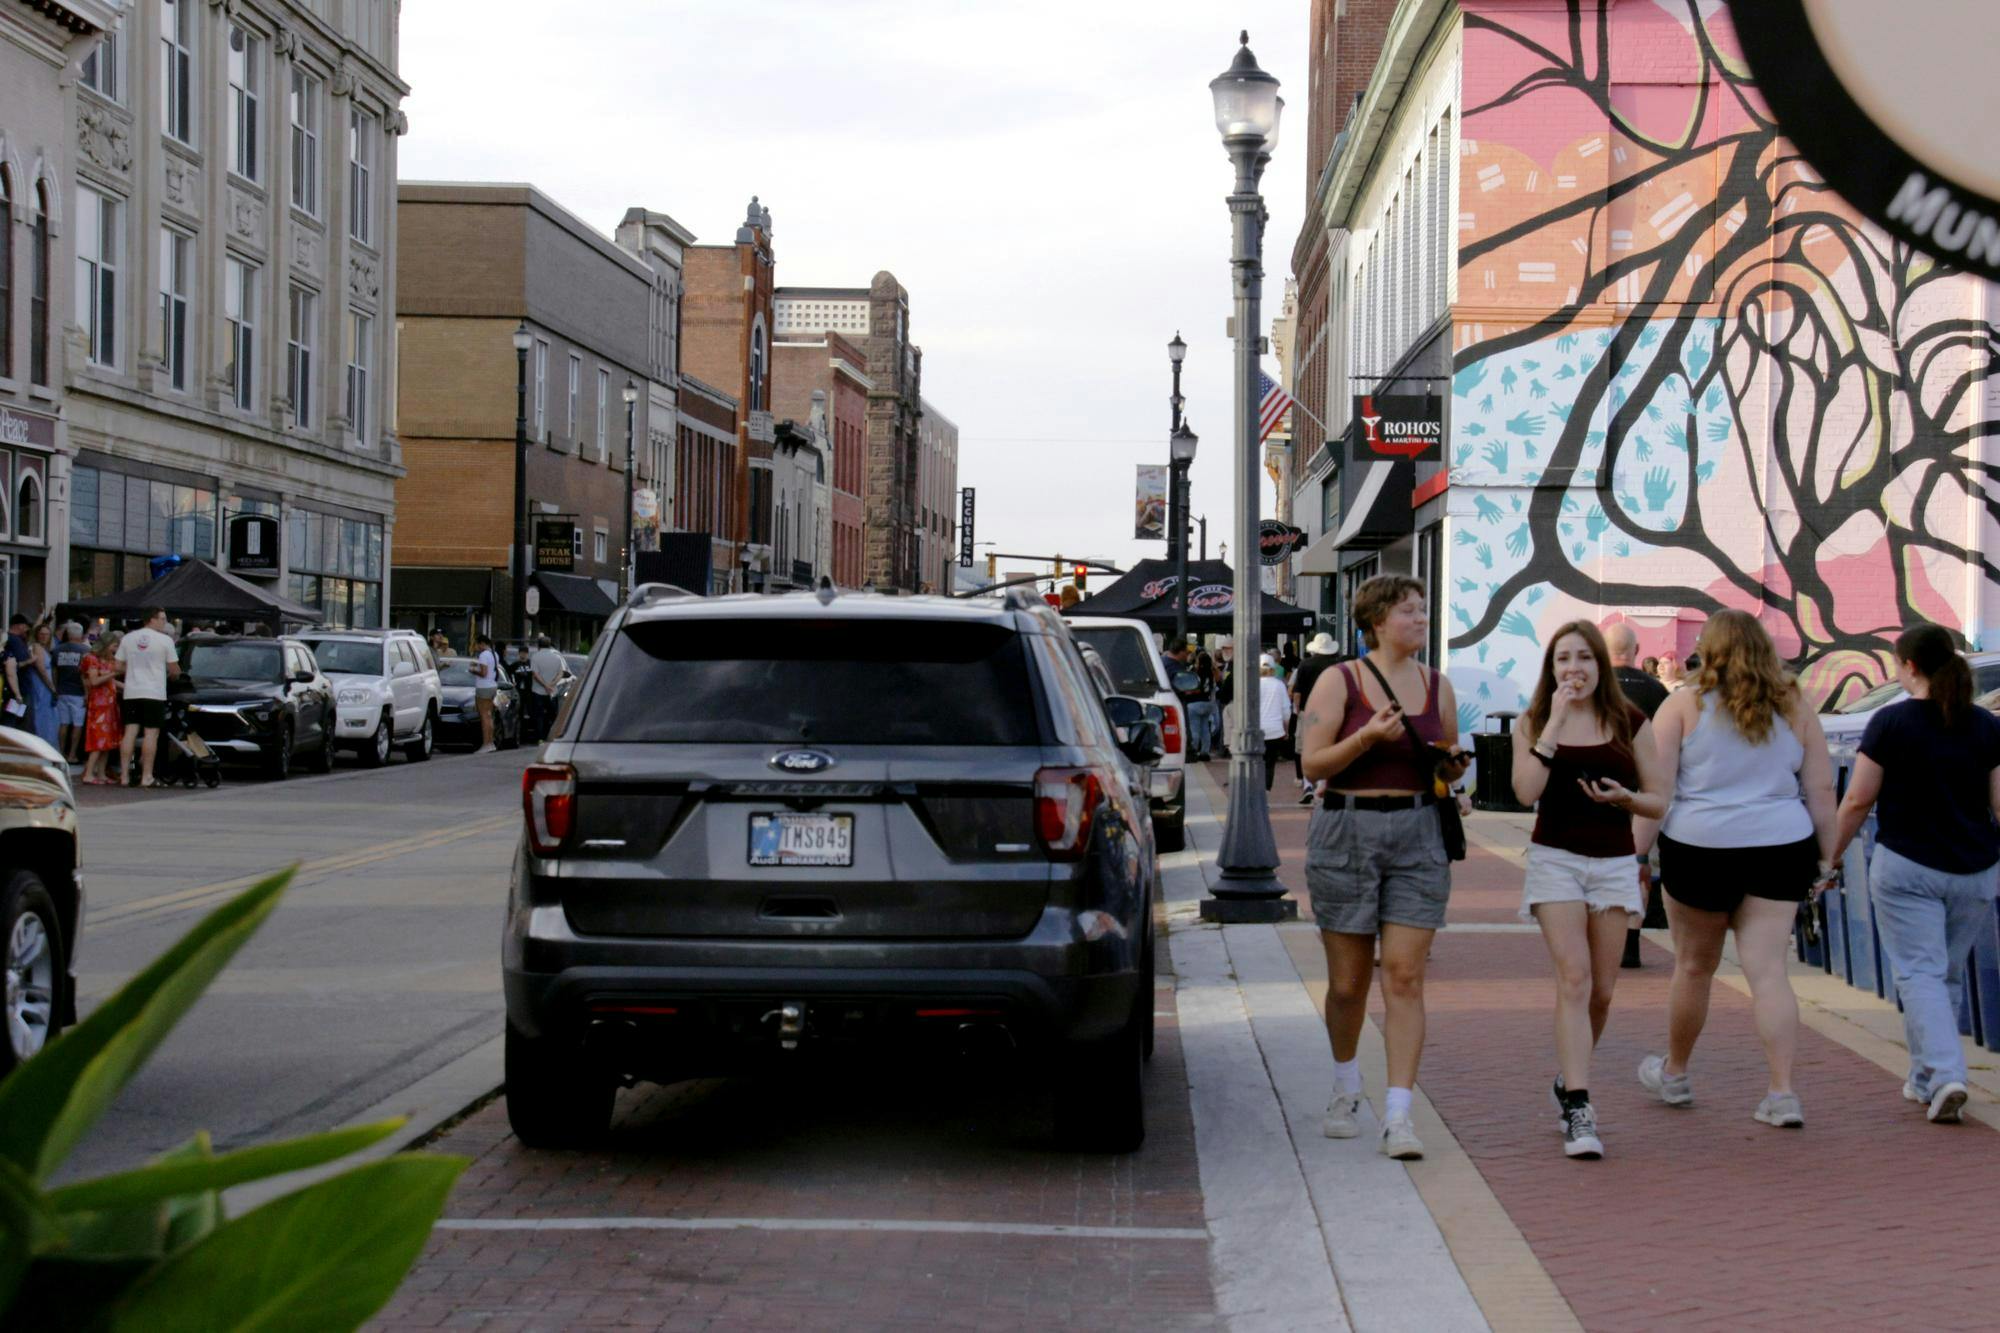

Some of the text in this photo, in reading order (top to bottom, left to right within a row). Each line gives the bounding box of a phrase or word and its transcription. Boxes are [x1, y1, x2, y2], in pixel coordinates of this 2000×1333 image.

[1885, 172, 2000, 267] MUN
[1384, 421, 1440, 435] ROHO'S
[962, 489, 974, 566] accutech
[538, 548, 571, 556] STEAK
[539, 557, 571, 565] HOUSE
[784, 754, 819, 769] Ford
[783, 826, 847, 849] TMS845
[750, 855, 779, 864] Audi
